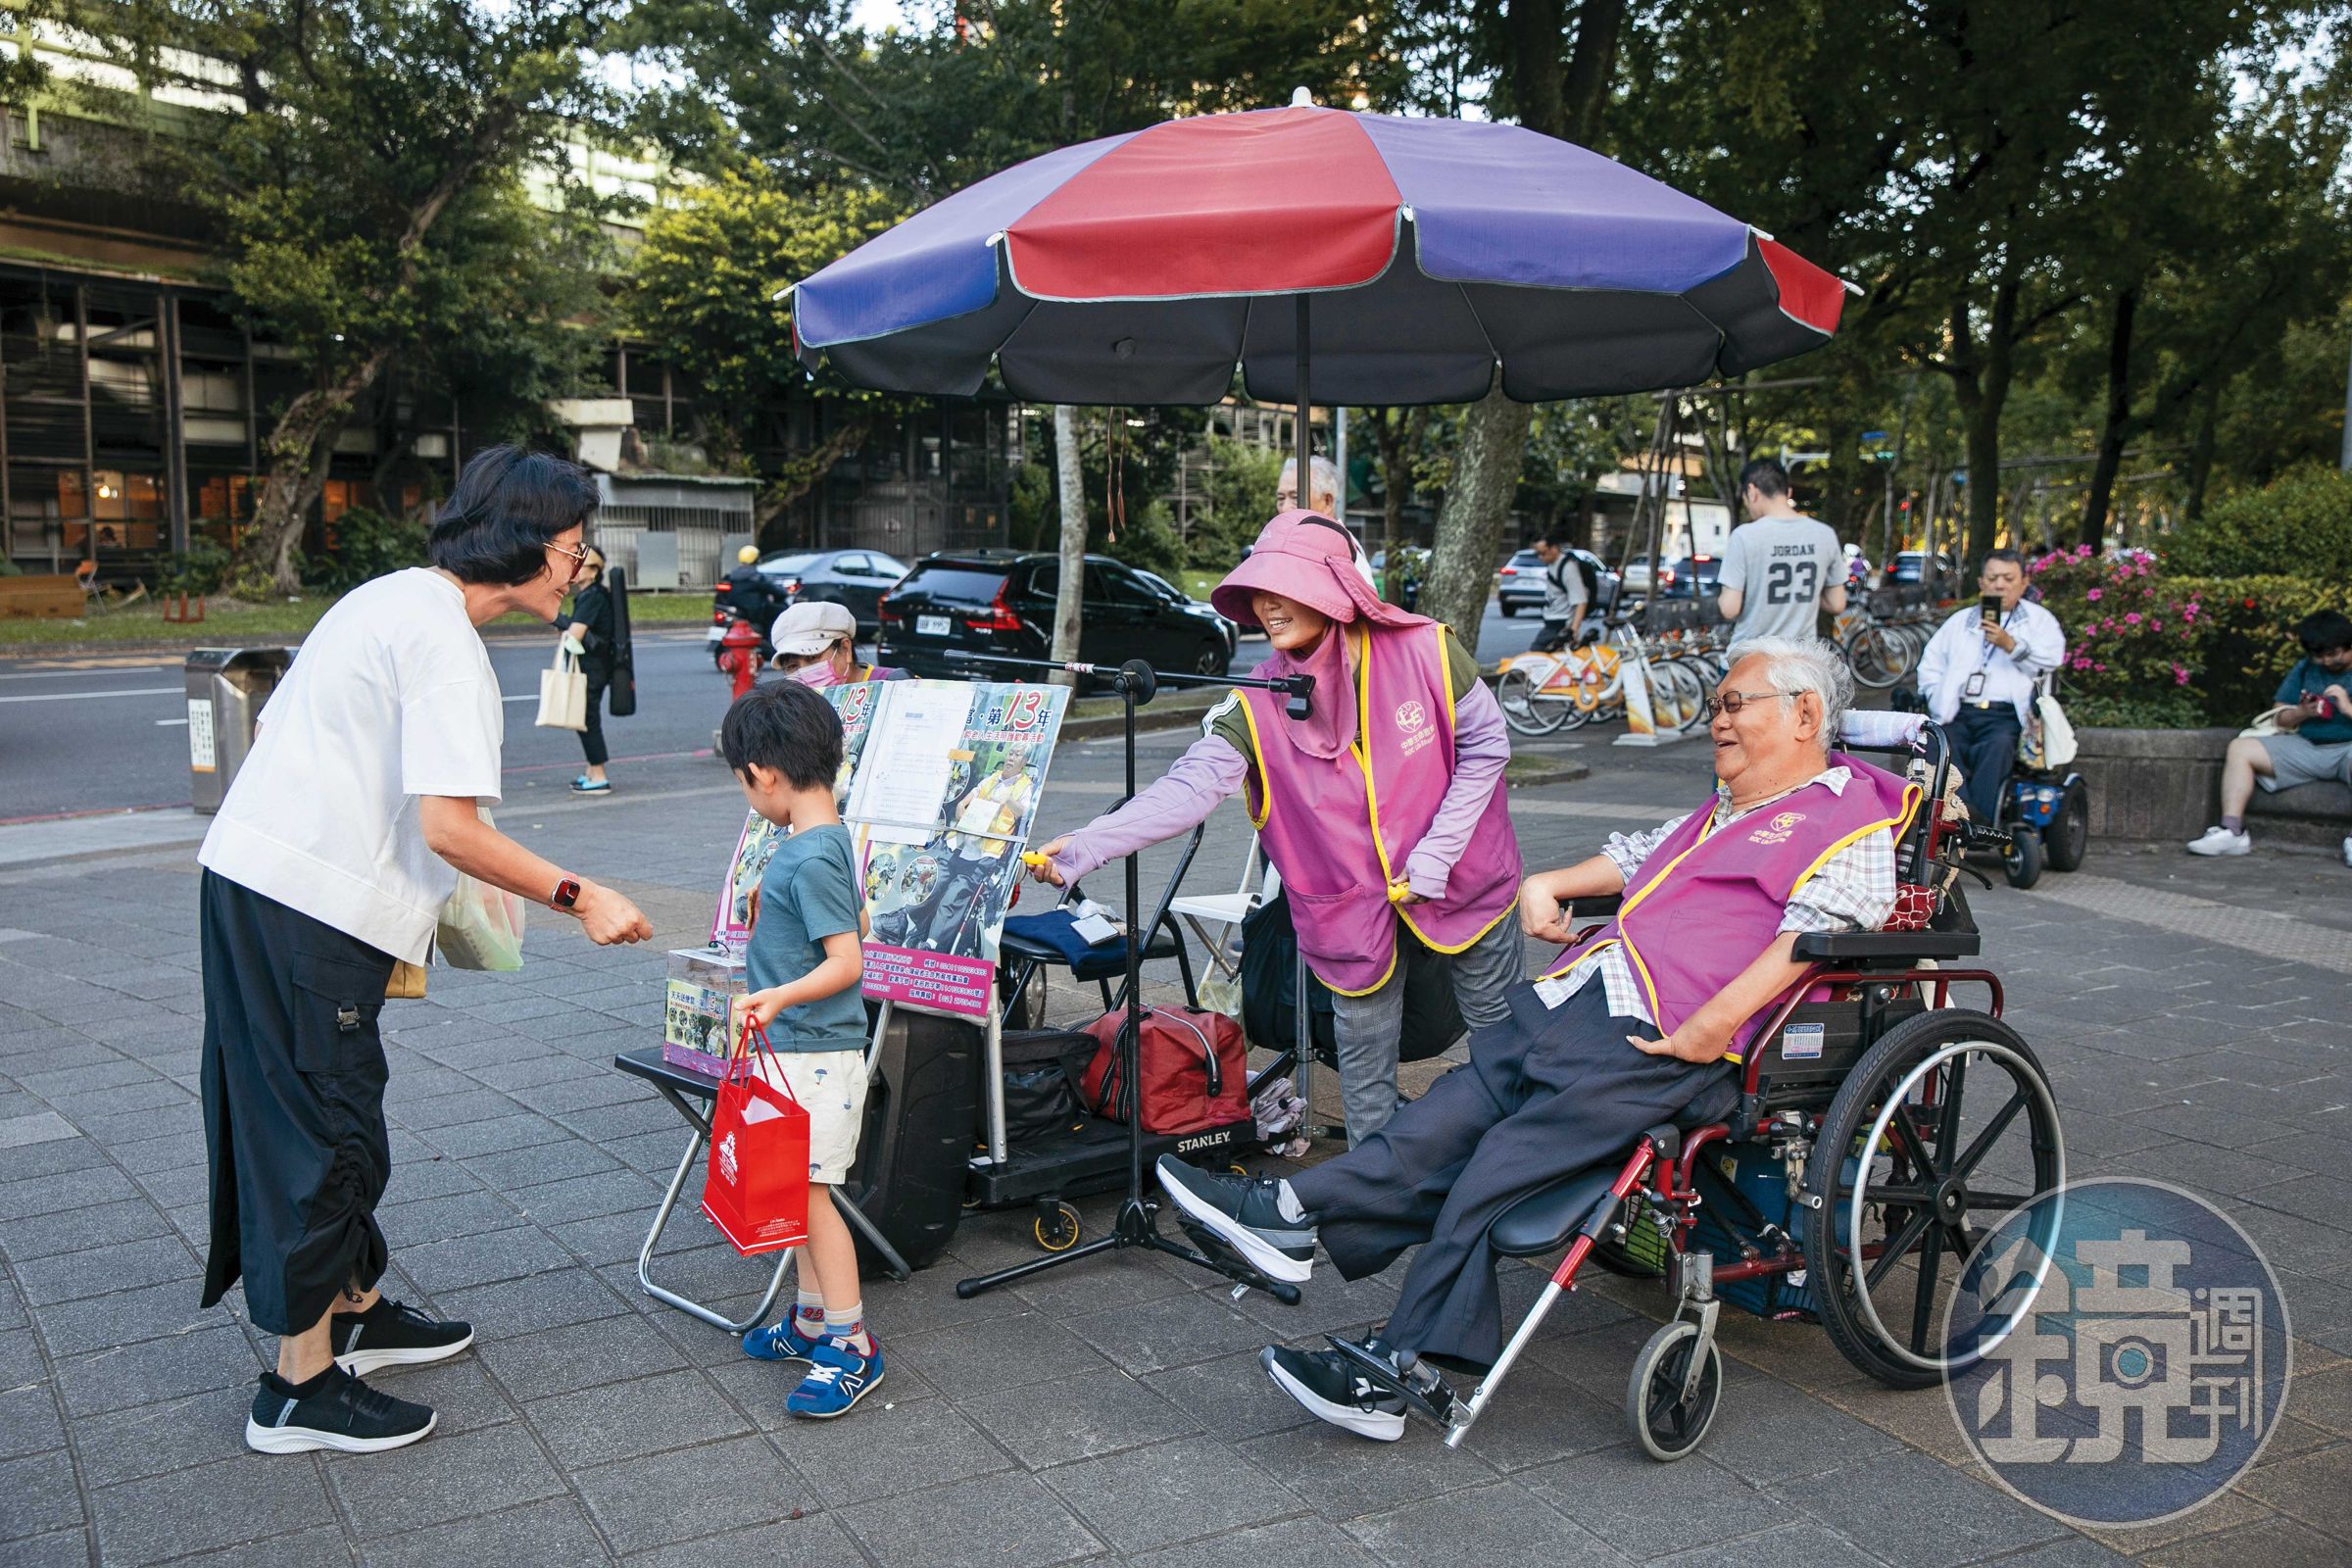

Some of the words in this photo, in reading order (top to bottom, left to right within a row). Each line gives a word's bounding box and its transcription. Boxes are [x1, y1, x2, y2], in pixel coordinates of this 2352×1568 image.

[1771, 543, 1815, 557] JORDAN
[1767, 562, 1817, 605] 23
[1177, 1131, 1231, 1153] STANLEY
